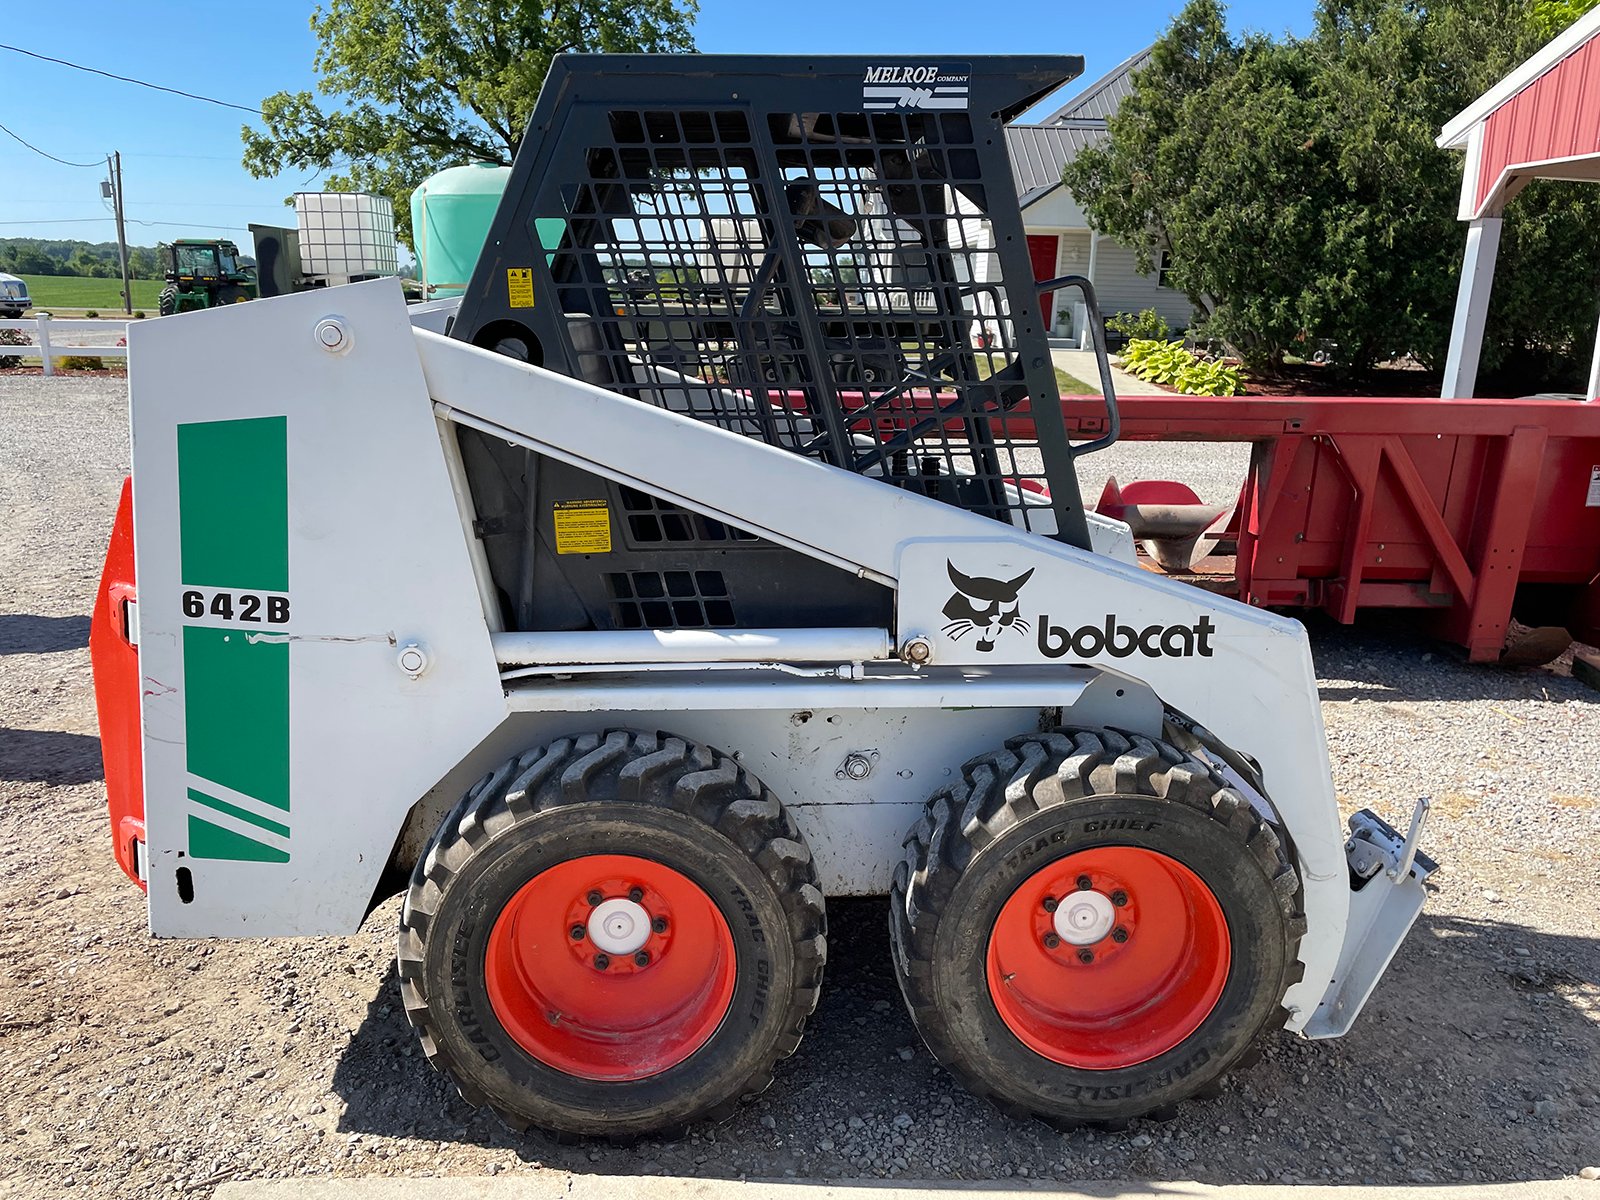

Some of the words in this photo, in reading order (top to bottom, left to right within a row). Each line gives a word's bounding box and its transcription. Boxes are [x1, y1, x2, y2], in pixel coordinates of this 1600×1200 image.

[863, 66, 938, 83] MELROE
[182, 591, 290, 623] 642B
[1038, 614, 1215, 658] bobcat
[1084, 820, 1164, 833] CHIEF
[451, 918, 501, 1062] CARLISLE
[1062, 1049, 1211, 1100] CARLISLE
